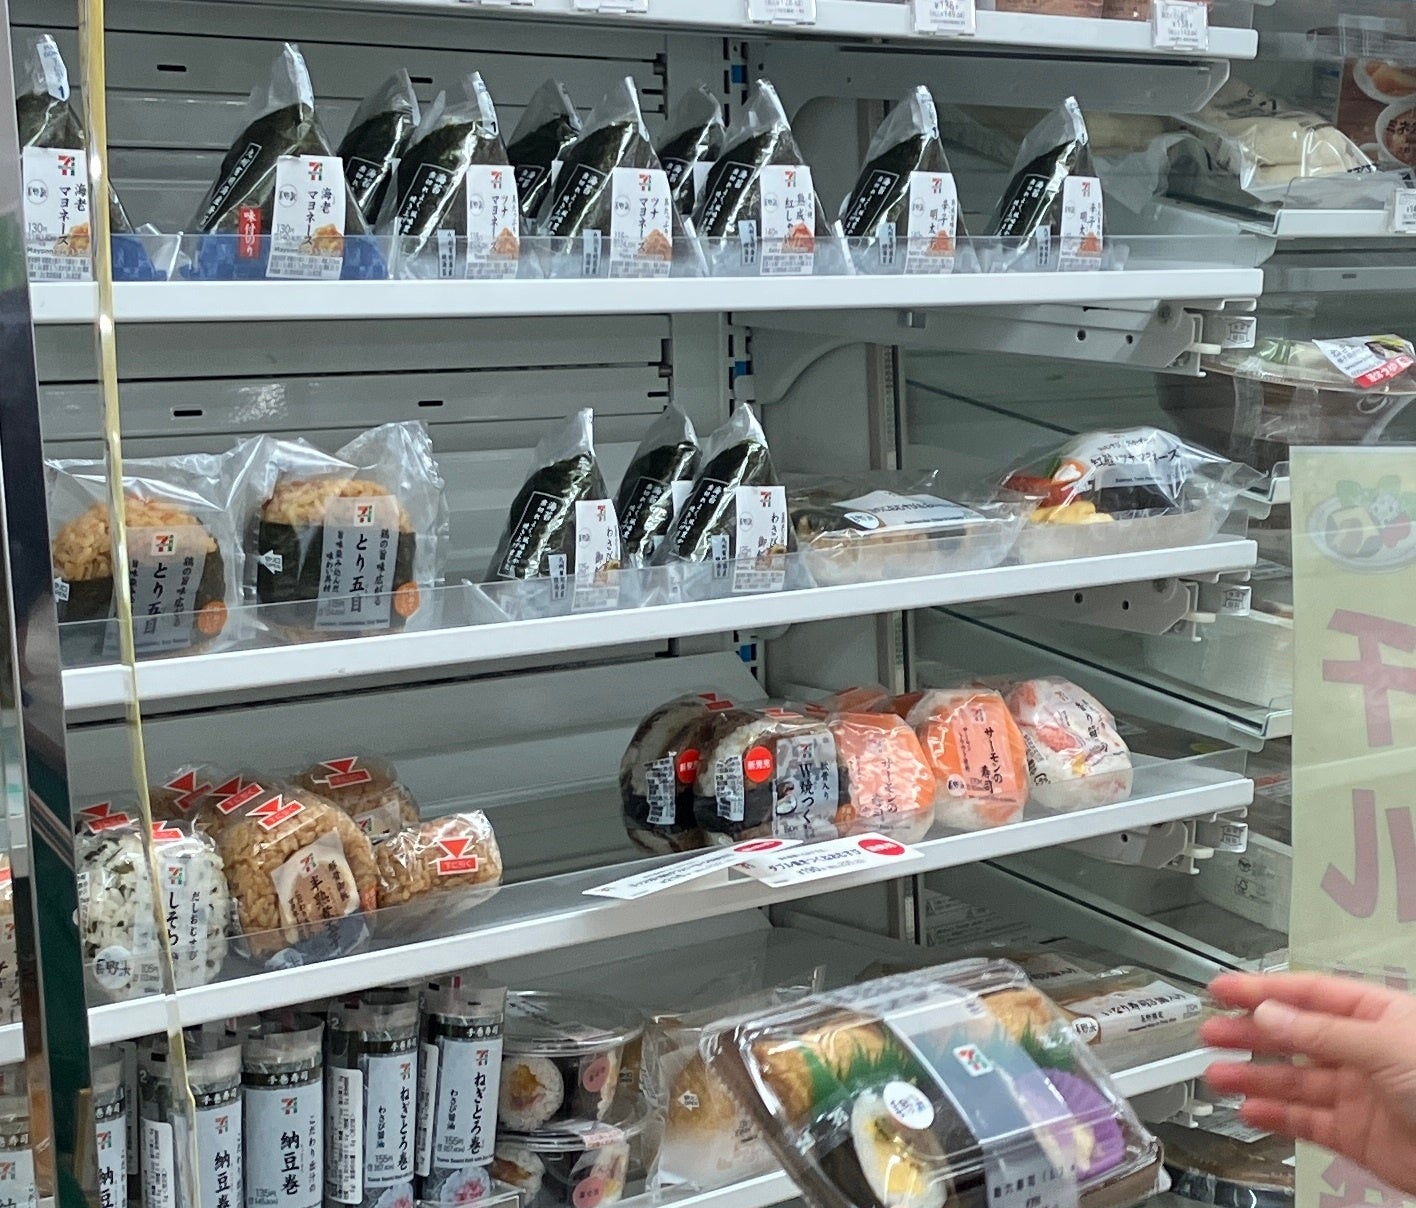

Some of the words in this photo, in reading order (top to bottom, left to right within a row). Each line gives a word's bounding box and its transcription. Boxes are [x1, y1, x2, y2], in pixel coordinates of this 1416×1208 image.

[58, 187, 71, 246] マヨネーズ
[75, 184, 87, 212] 海老
[300, 190, 318, 246] マヨネーズ
[321, 187, 332, 215] 海老
[144, 562, 168, 635] とり五目
[349, 533, 368, 613] とり五目
[747, 760, 771, 770] 新発売
[983, 726, 1003, 784] サーモンの
[398, 1086, 411, 1172] ねぎとろ巻
[470, 1071, 487, 1155] ねぎとろ巻
[280, 1130, 300, 1196] 納豆巻
